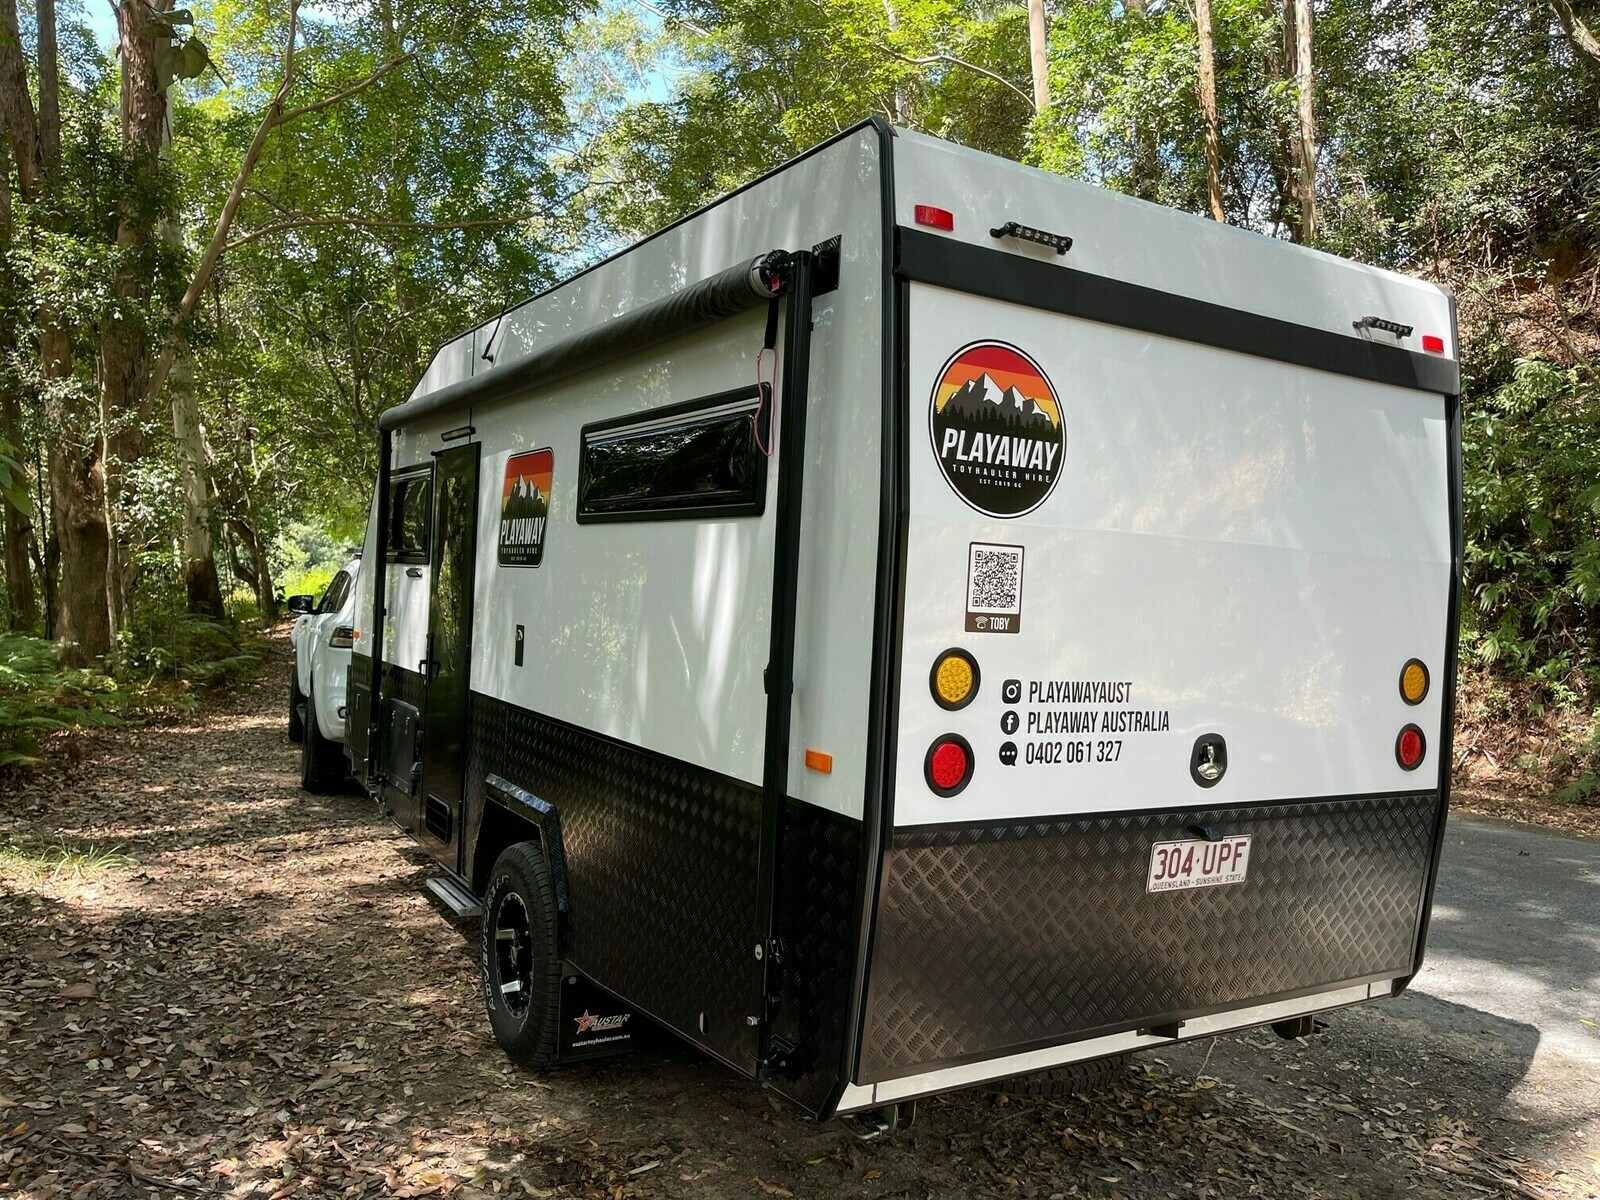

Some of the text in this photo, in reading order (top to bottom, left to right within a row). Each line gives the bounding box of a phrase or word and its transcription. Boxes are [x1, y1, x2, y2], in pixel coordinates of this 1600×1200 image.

[941, 428, 1059, 471] PLAYAWAY
[952, 464, 1050, 483] TOYHAULER HIRE
[499, 516, 546, 545] PLAYAWAY
[989, 616, 1010, 630] TOBY
[1028, 680, 1133, 704] PLAYAWAYAUST
[1027, 710, 1170, 734] PLAYAWAY AUSTRALIA
[1025, 740, 1123, 765] 0402 061 327
[1152, 879, 1191, 891] QUEENSLAND
[1195, 875, 1223, 886] SUNSHINE
[1226, 873, 1242, 881] STATE
[589, 1013, 631, 1027] AUSTAR
